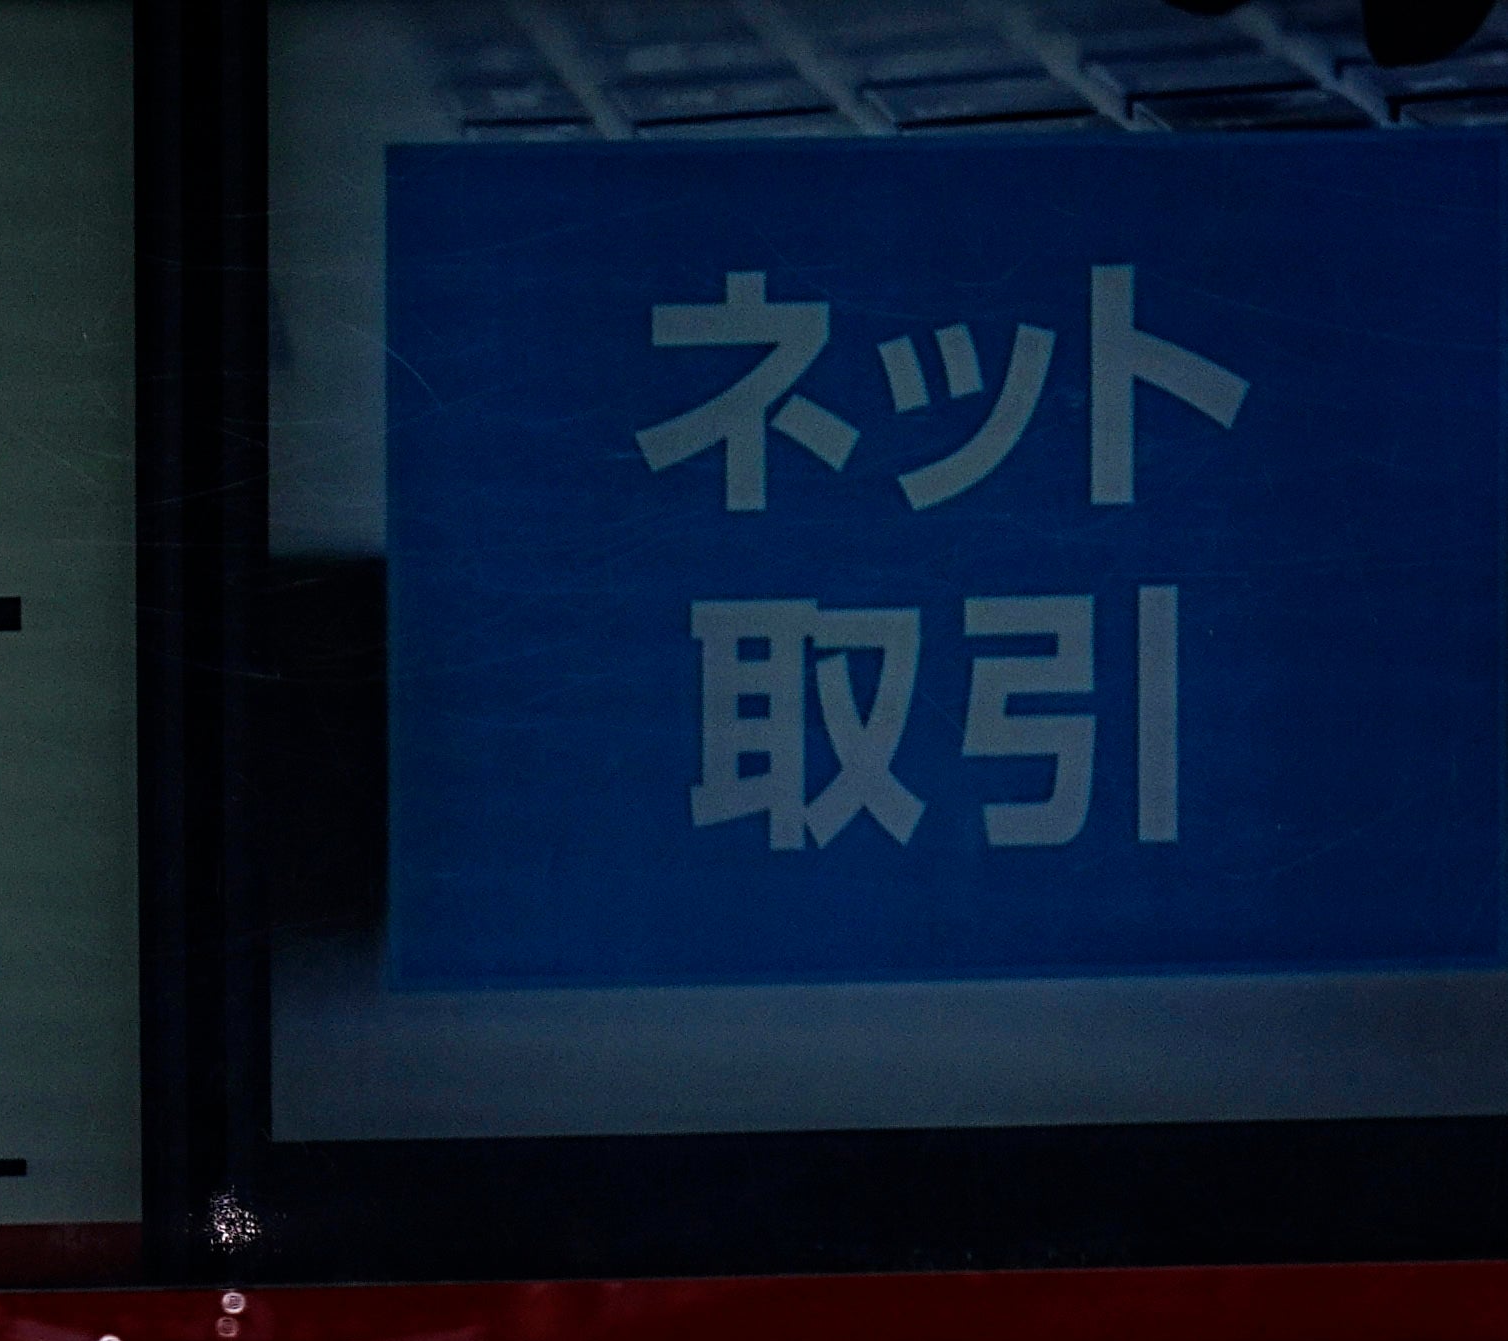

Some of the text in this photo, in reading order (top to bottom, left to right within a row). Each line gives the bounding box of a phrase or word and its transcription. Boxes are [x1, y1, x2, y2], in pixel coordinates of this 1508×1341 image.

[634, 263, 1253, 514] ネット
[688, 583, 1180, 853] 取引
